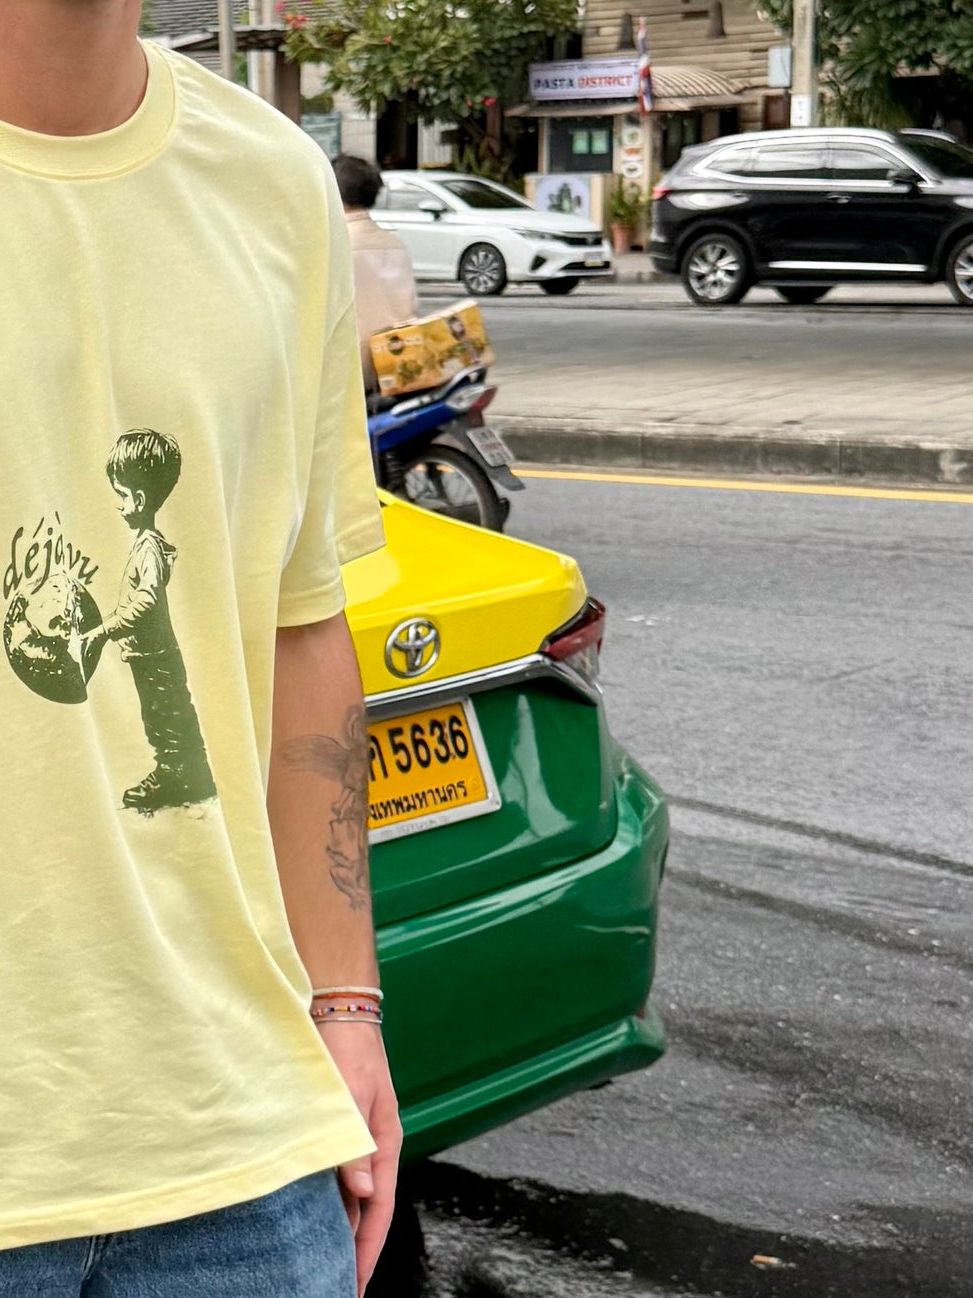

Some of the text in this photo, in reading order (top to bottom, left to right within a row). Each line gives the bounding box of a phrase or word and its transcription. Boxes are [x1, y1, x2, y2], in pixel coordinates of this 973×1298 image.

[533, 75, 634, 91] PASTA DISTRICT
[388, 715, 469, 774] 5636
[370, 780, 468, 821] งเทพมหานคร
